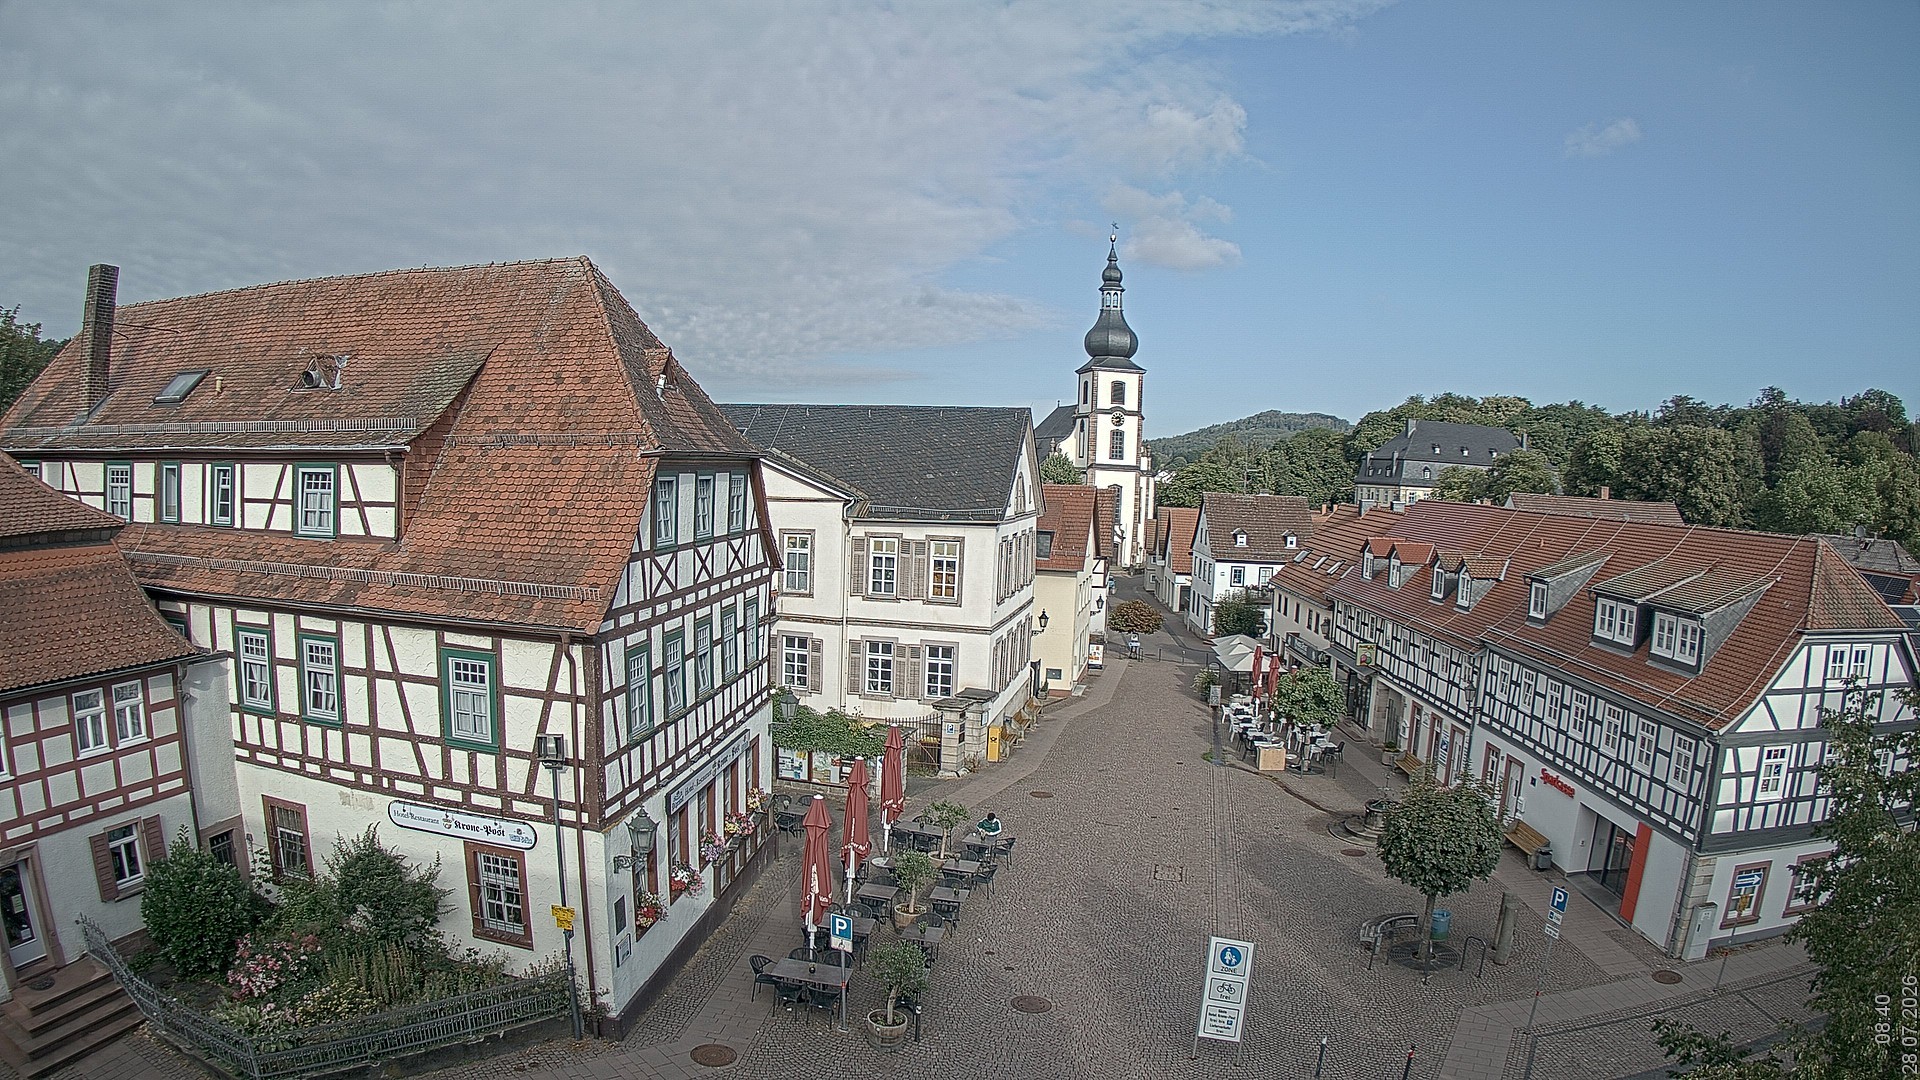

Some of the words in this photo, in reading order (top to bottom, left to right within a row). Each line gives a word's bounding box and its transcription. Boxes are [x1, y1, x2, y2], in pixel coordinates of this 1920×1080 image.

[1540, 768, 1575, 799] Sparkasse
[454, 820, 506, 836] Krone-Post
[1554, 891, 1564, 906] P
[836, 919, 848, 934] P
[1221, 966, 1237, 974] ZONE
[1220, 993, 1231, 1001] frei
